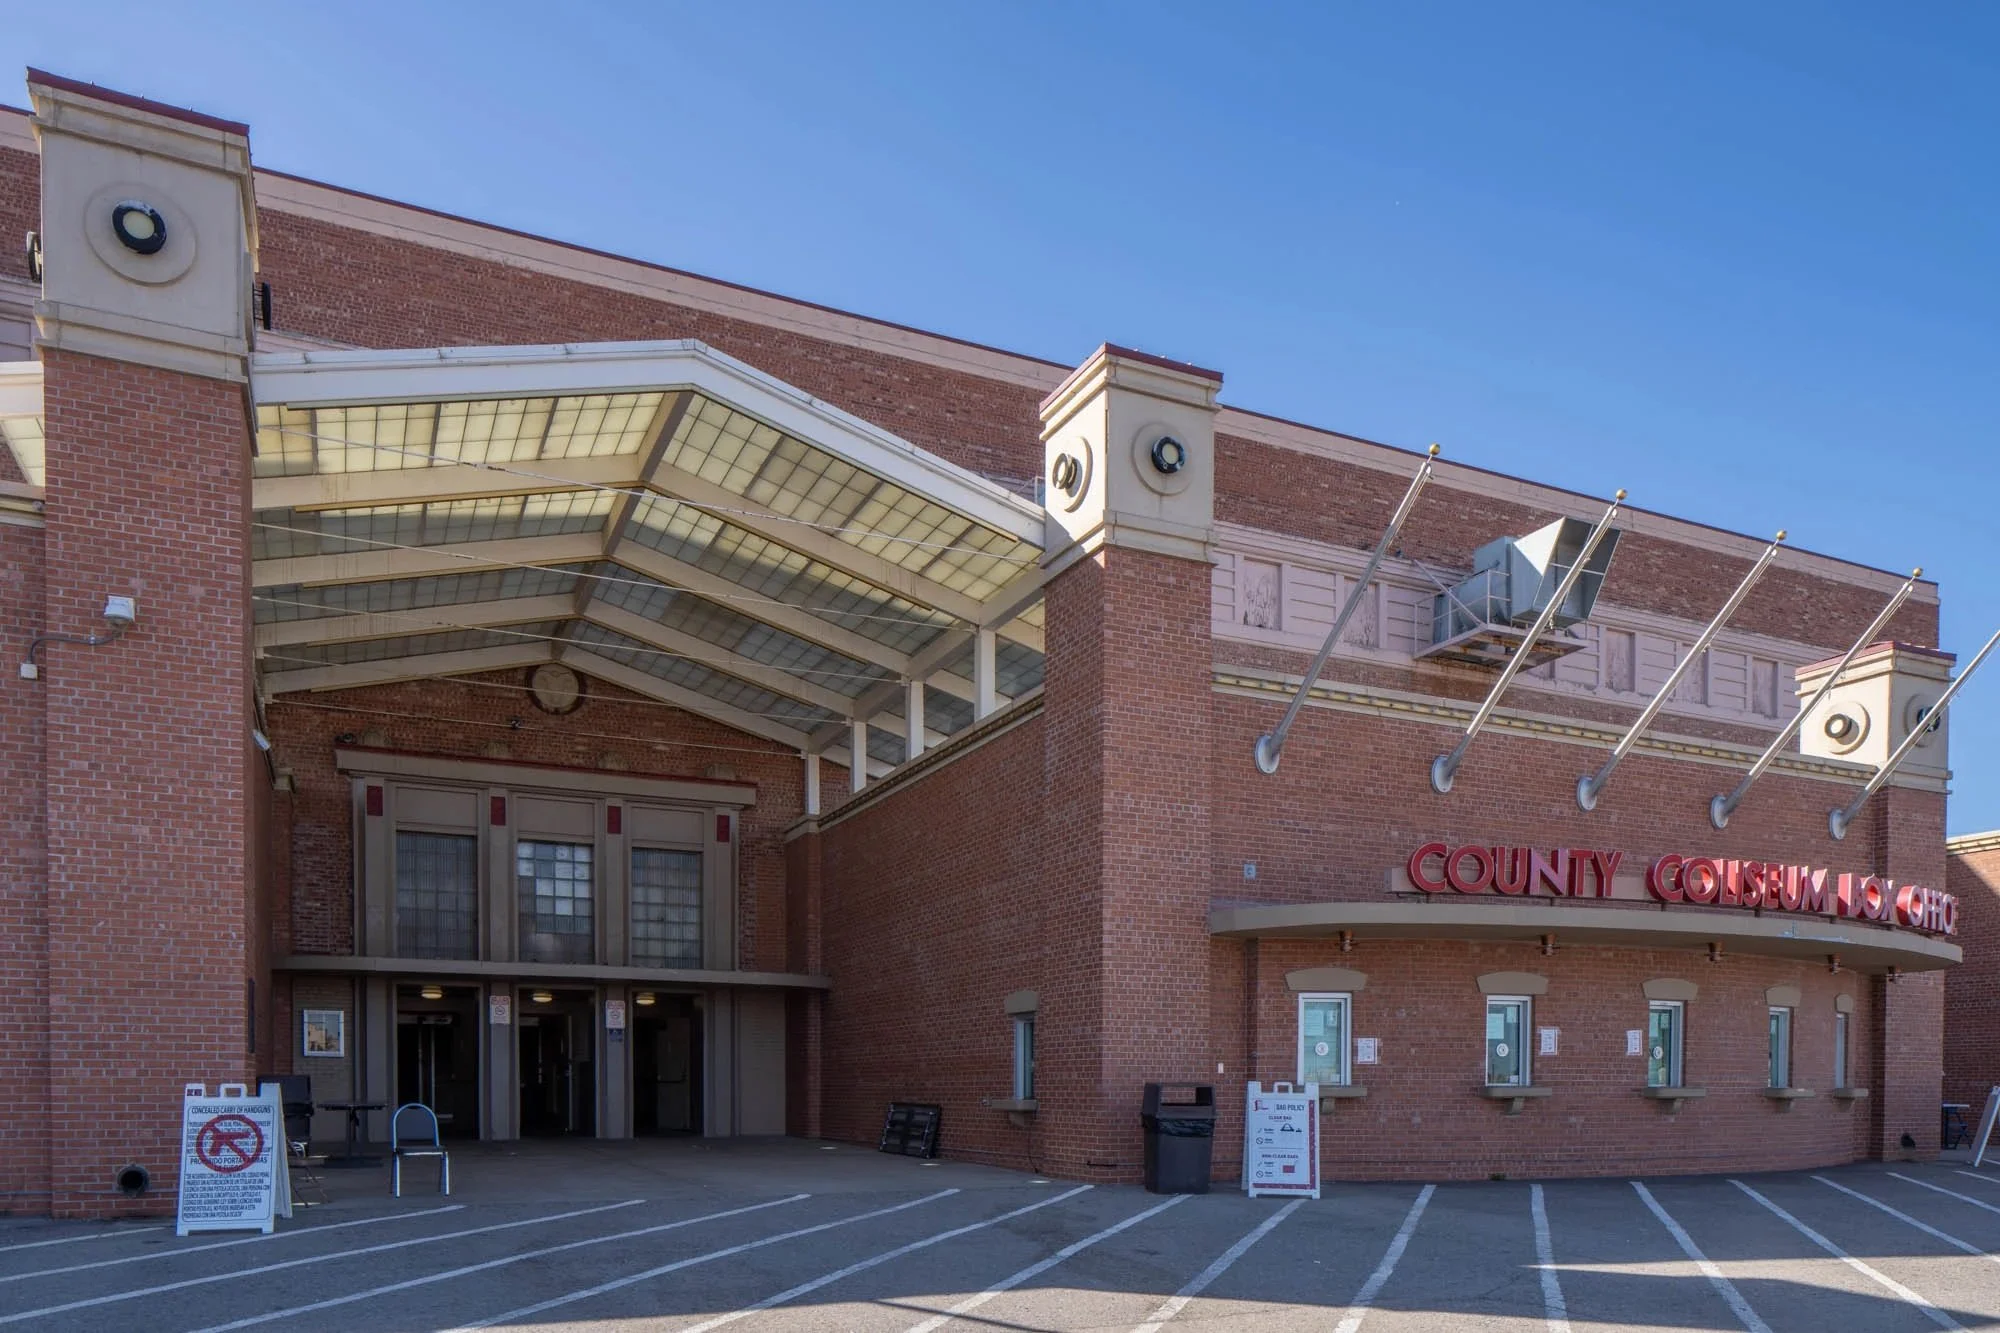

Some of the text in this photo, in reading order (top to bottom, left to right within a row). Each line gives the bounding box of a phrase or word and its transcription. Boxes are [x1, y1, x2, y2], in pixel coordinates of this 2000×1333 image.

[1407, 842, 1624, 898] COUNTY
[1646, 853, 1831, 914] COLISEUM
[1837, 872, 1895, 921] BOX
[191, 1106, 219, 1114] CONCEALED
[221, 1106, 236, 1114] CARRY
[244, 1106, 271, 1114] HANDGUNS
